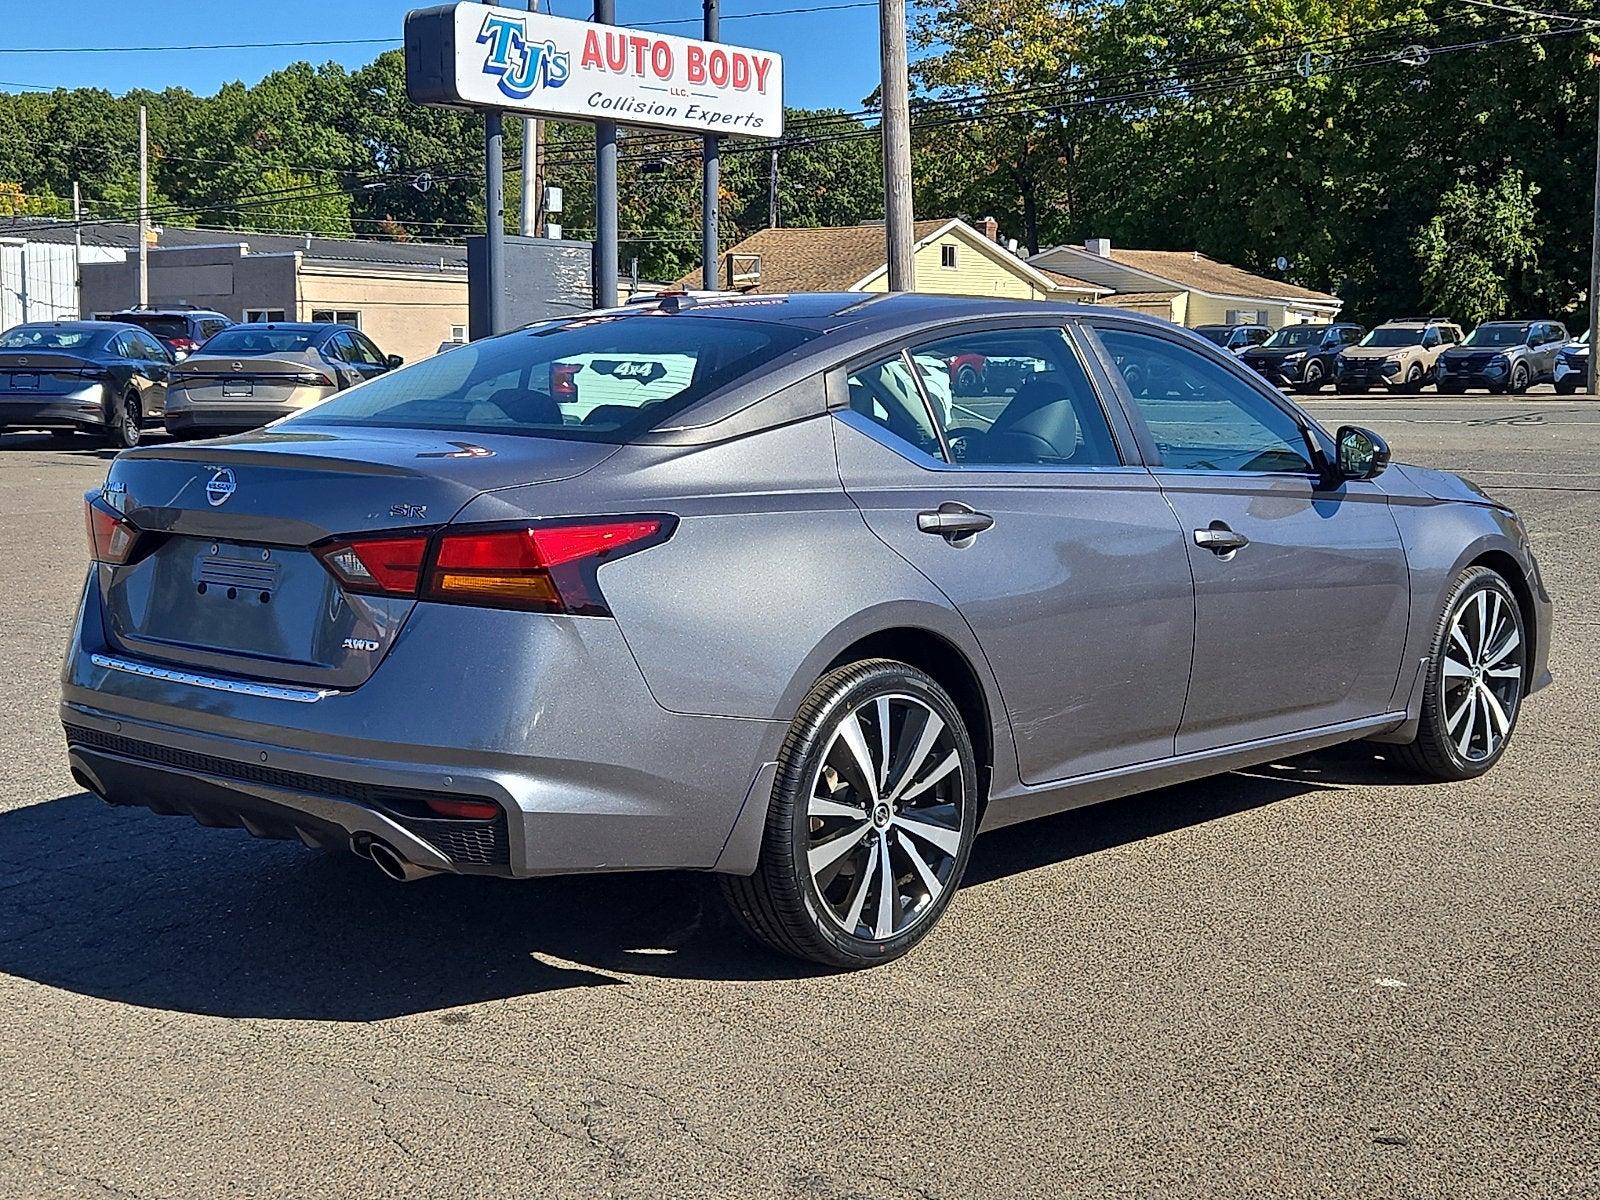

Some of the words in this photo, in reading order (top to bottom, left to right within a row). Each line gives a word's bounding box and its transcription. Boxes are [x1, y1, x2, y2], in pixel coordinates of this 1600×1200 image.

[580, 29, 673, 79] AUTO
[687, 45, 772, 94] BODY
[670, 87, 690, 98] LLC.
[587, 91, 678, 118] Collision
[684, 104, 765, 129] Experts
[389, 503, 427, 519] SR
[341, 638, 379, 651] AWD
